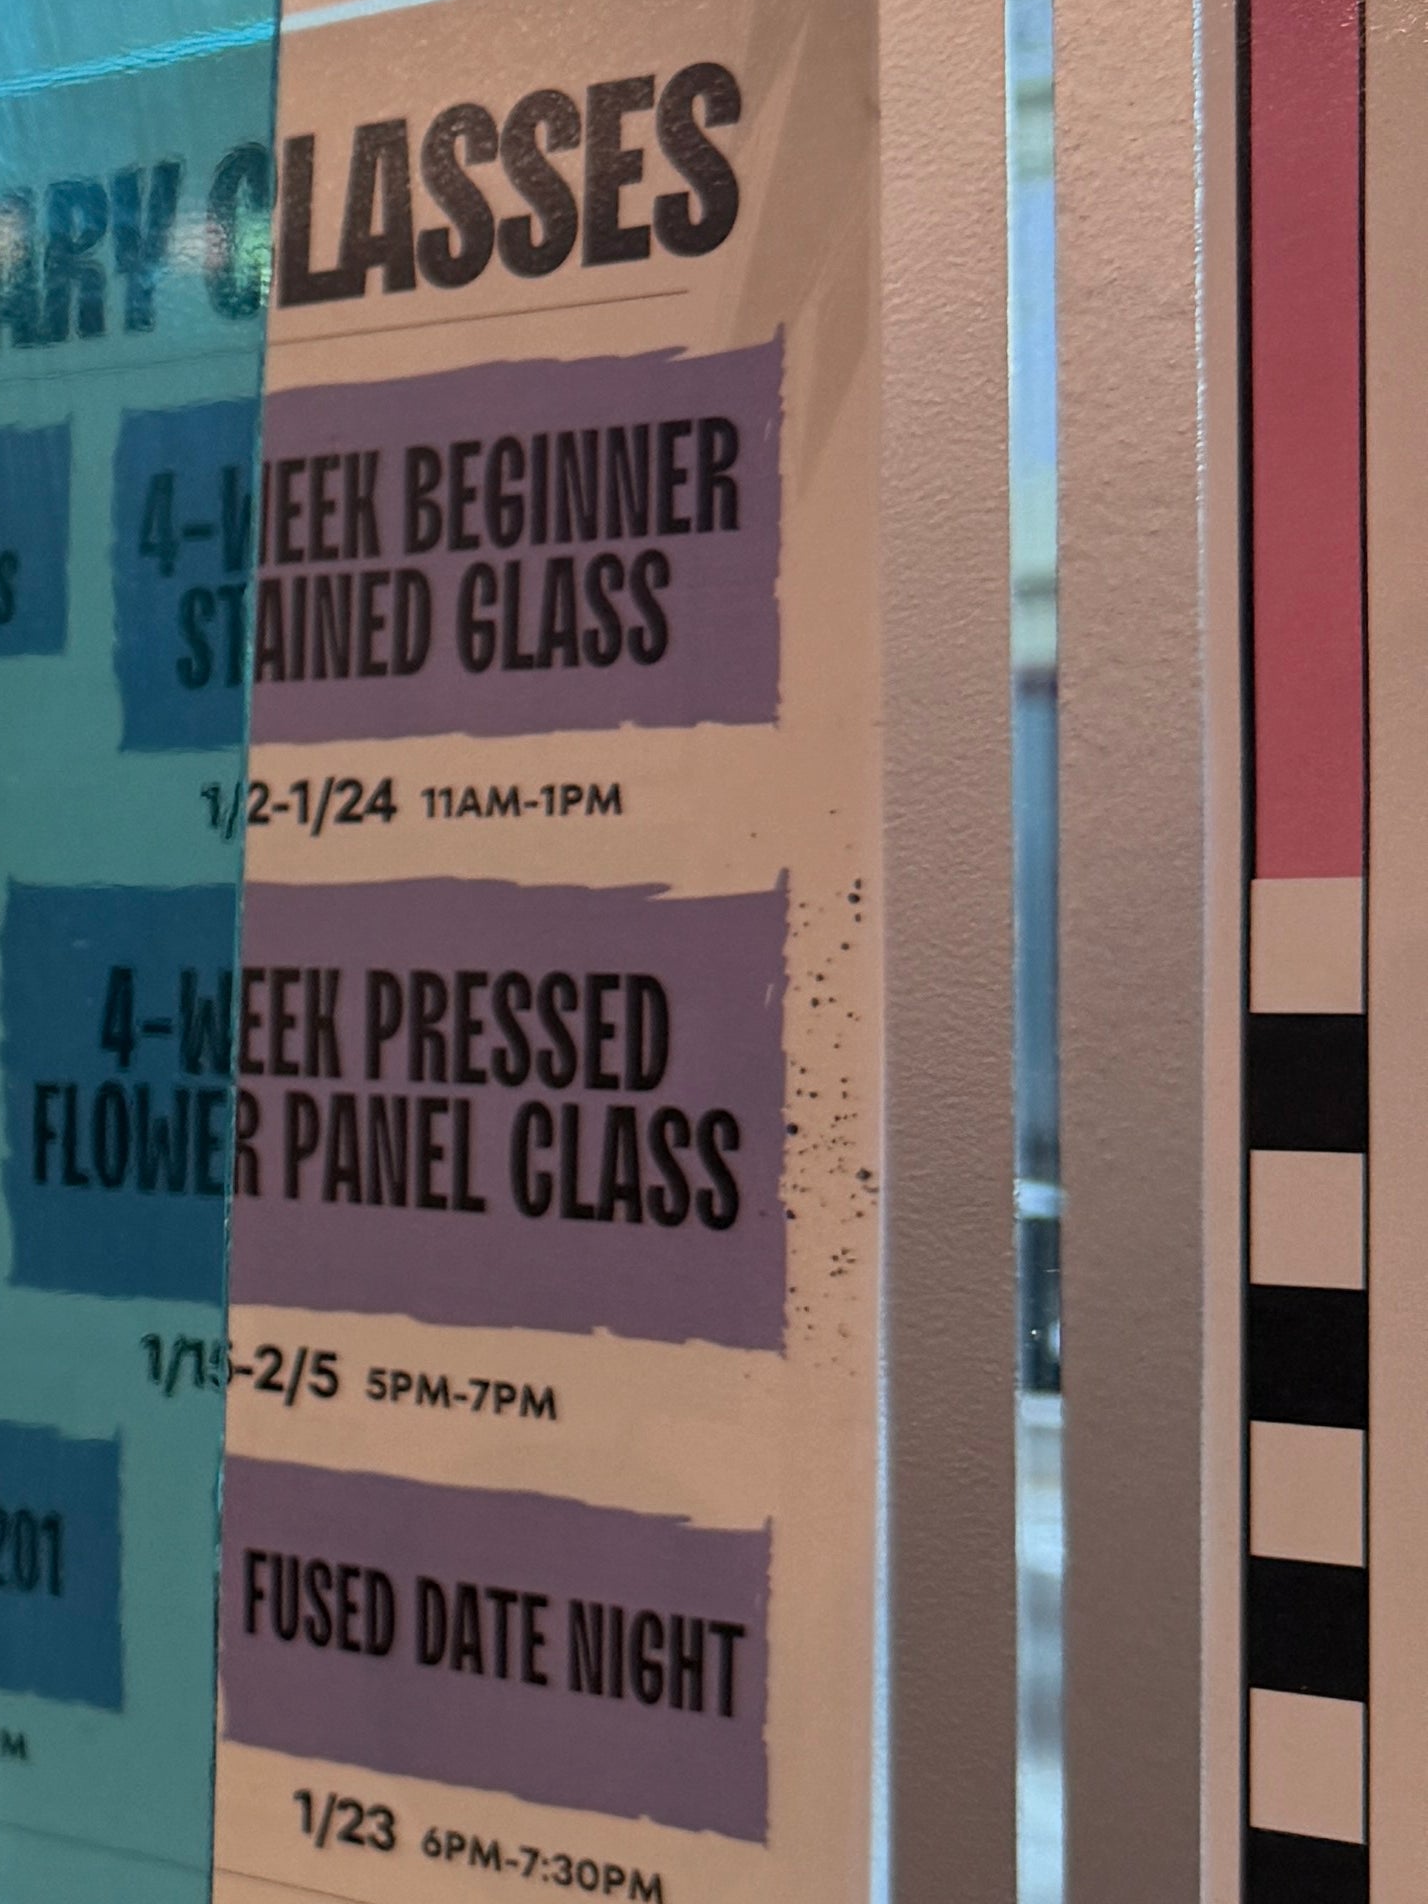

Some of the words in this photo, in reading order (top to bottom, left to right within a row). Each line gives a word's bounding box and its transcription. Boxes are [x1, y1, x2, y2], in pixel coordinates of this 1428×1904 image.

[204, 60, 743, 320] CLASSES
[137, 449, 382, 578] 4-WEEK
[403, 415, 741, 557] BEGINNER
[174, 566, 432, 692] STAINED
[455, 548, 671, 675] GLASS
[199, 777, 398, 841] 1/2-1/24
[420, 782, 624, 821] 11AM-1PM
[99, 964, 342, 1081] 4-WEEK
[364, 968, 672, 1092] PRESSED
[32, 1080, 262, 1198] FLOWER
[284, 1091, 487, 1215] PANEL
[509, 1099, 742, 1233] CLASS
[140, 1331, 340, 1407] 1/15-2/5
[364, 1367, 559, 1422] 5PM-7PM
[243, 1547, 397, 1658] FUSED
[416, 1575, 549, 1687] DATE
[567, 1597, 747, 1719] NIGHT
[292, 1787, 398, 1852] 1/23
